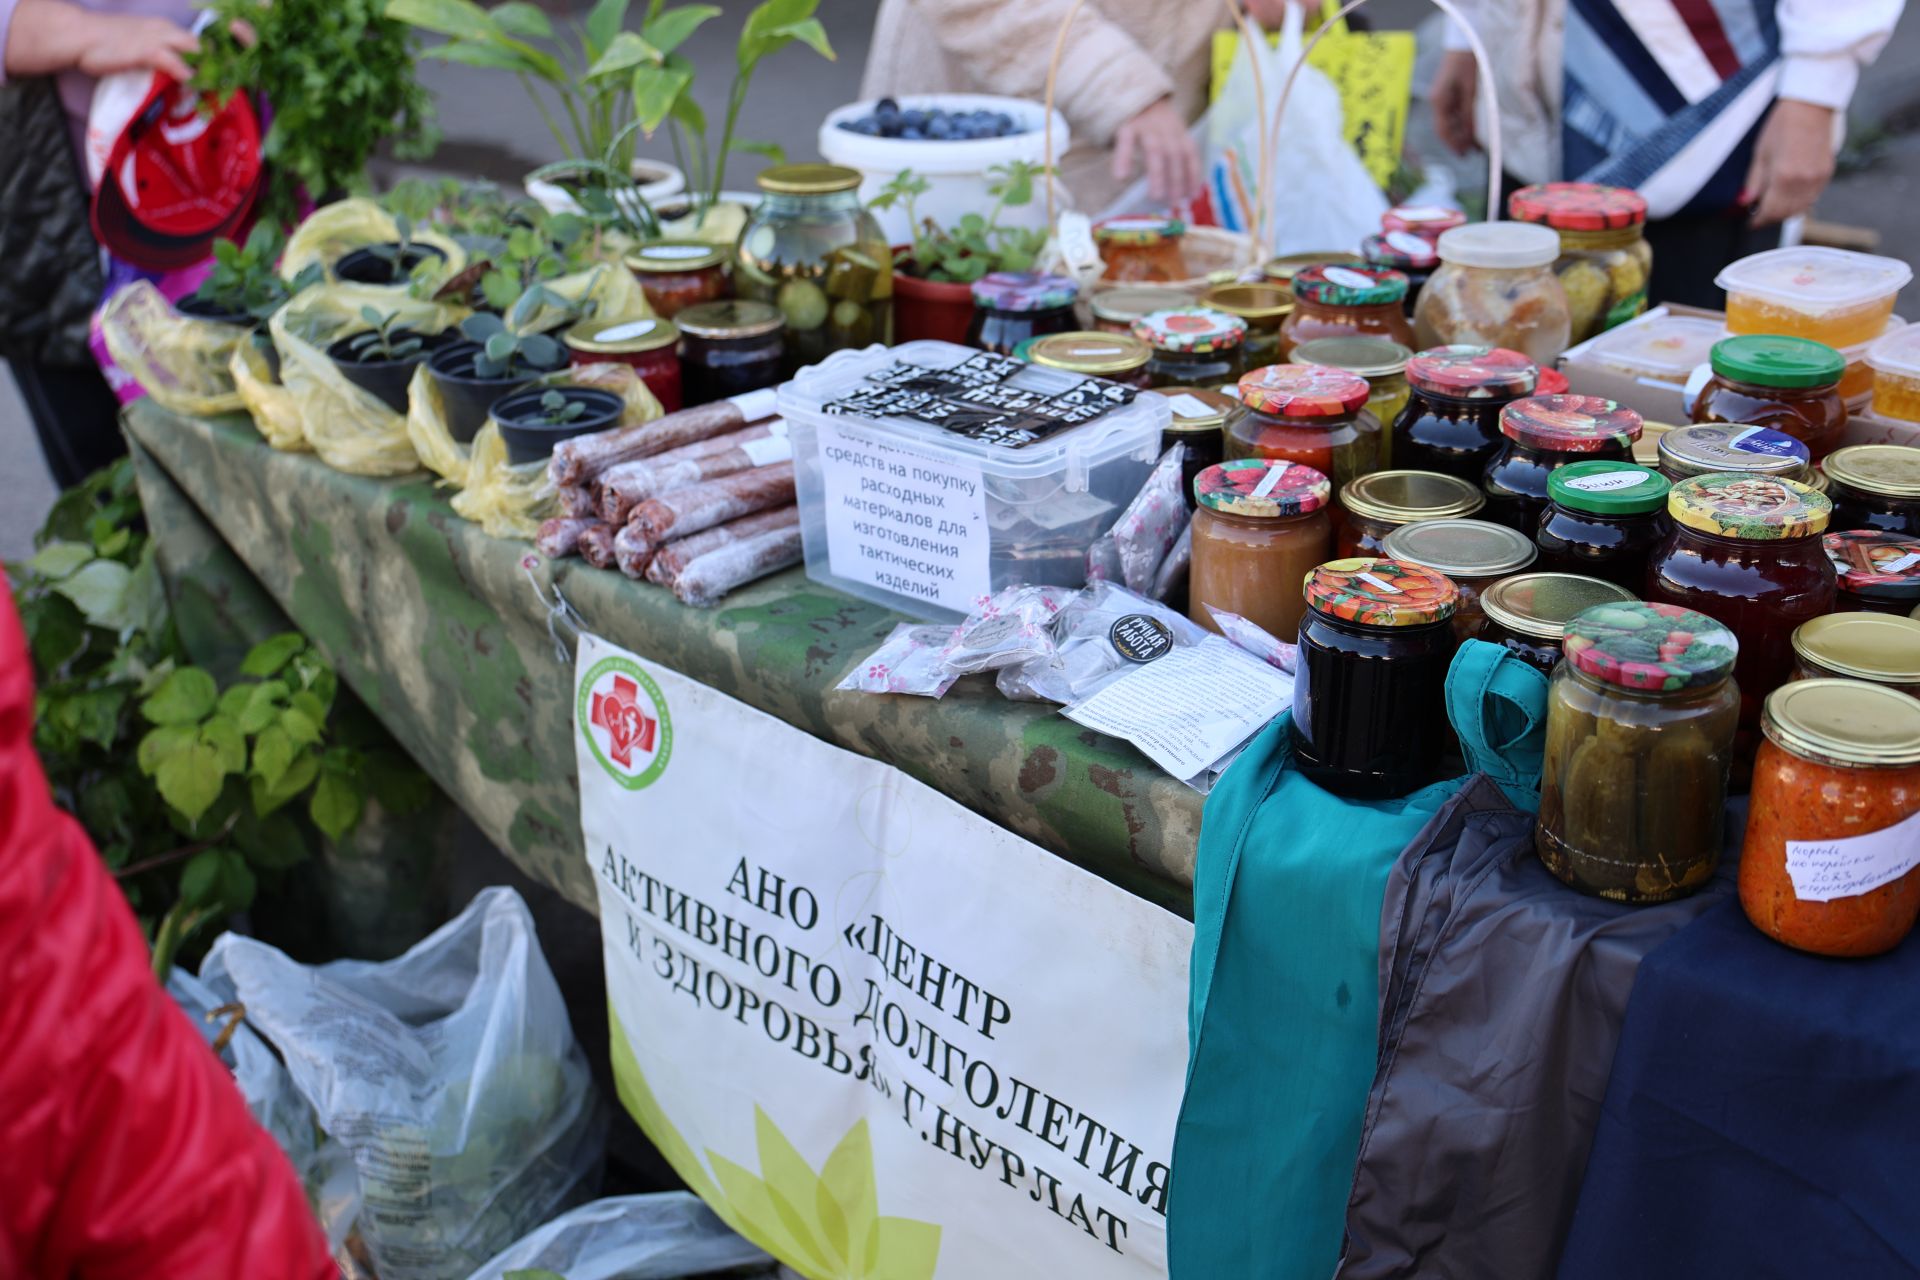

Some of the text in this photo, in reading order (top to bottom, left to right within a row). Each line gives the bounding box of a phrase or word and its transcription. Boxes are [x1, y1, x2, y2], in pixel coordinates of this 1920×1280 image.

[826, 445, 885, 472] средств
[889, 461, 907, 478] на
[913, 468, 976, 497] покупку
[861, 476, 945, 508] расходных
[843, 496, 968, 537] материалов для
[853, 520, 959, 558] изготовления
[859, 544, 955, 580] тактических
[875, 570, 940, 599] изделий
[1116, 624, 1154, 658] РАБОТА
[1129, 617, 1167, 648] РУЧНАЯ
[726, 856, 1011, 1041] АНО «ЦЕНТР
[602, 844, 1171, 1217] АКТИВНОГО ДОЛГОЛЕТИЯ
[627, 912, 1128, 1255] И ЗДОРОВЬЯ» Г.НУРЛАТ
